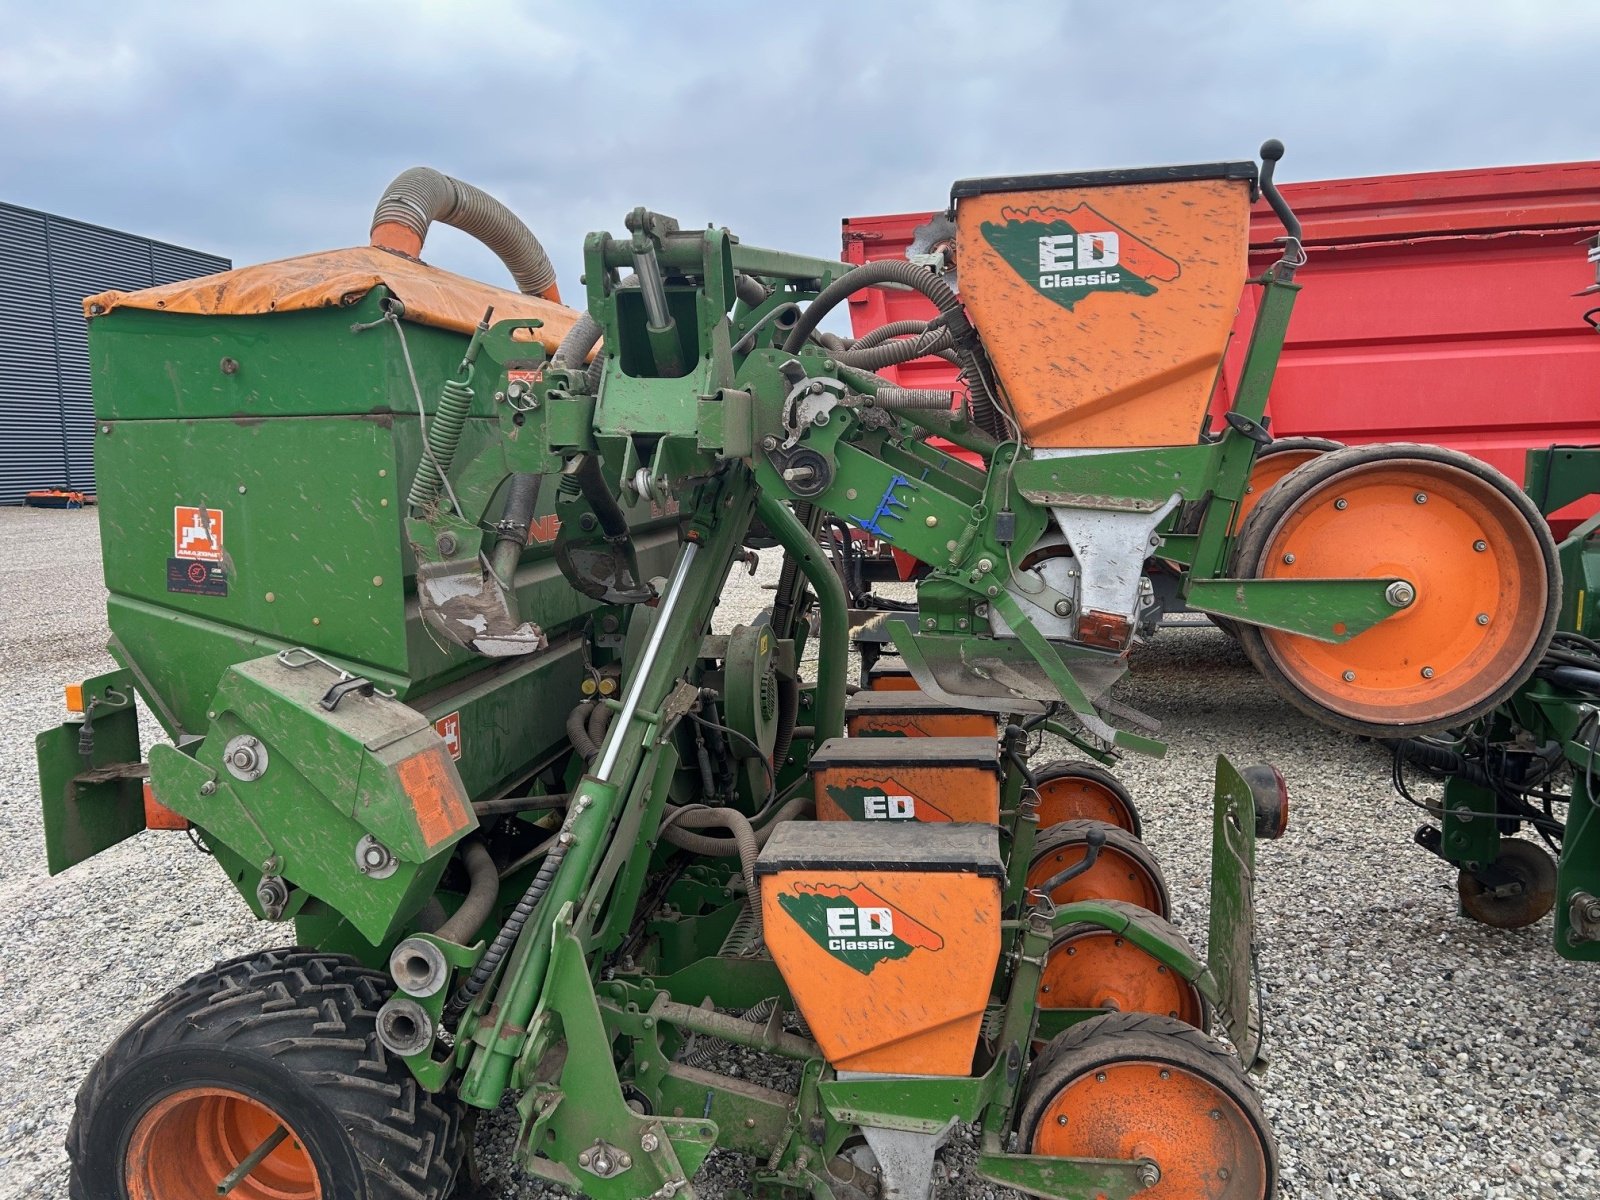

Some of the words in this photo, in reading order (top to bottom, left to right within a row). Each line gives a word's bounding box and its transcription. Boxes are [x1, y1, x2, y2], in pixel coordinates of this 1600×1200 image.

[1039, 231, 1119, 272] ED
[1040, 271, 1120, 289] Classic
[863, 795, 915, 819] ED
[826, 907, 893, 937] ED
[828, 938, 895, 951] Classic
